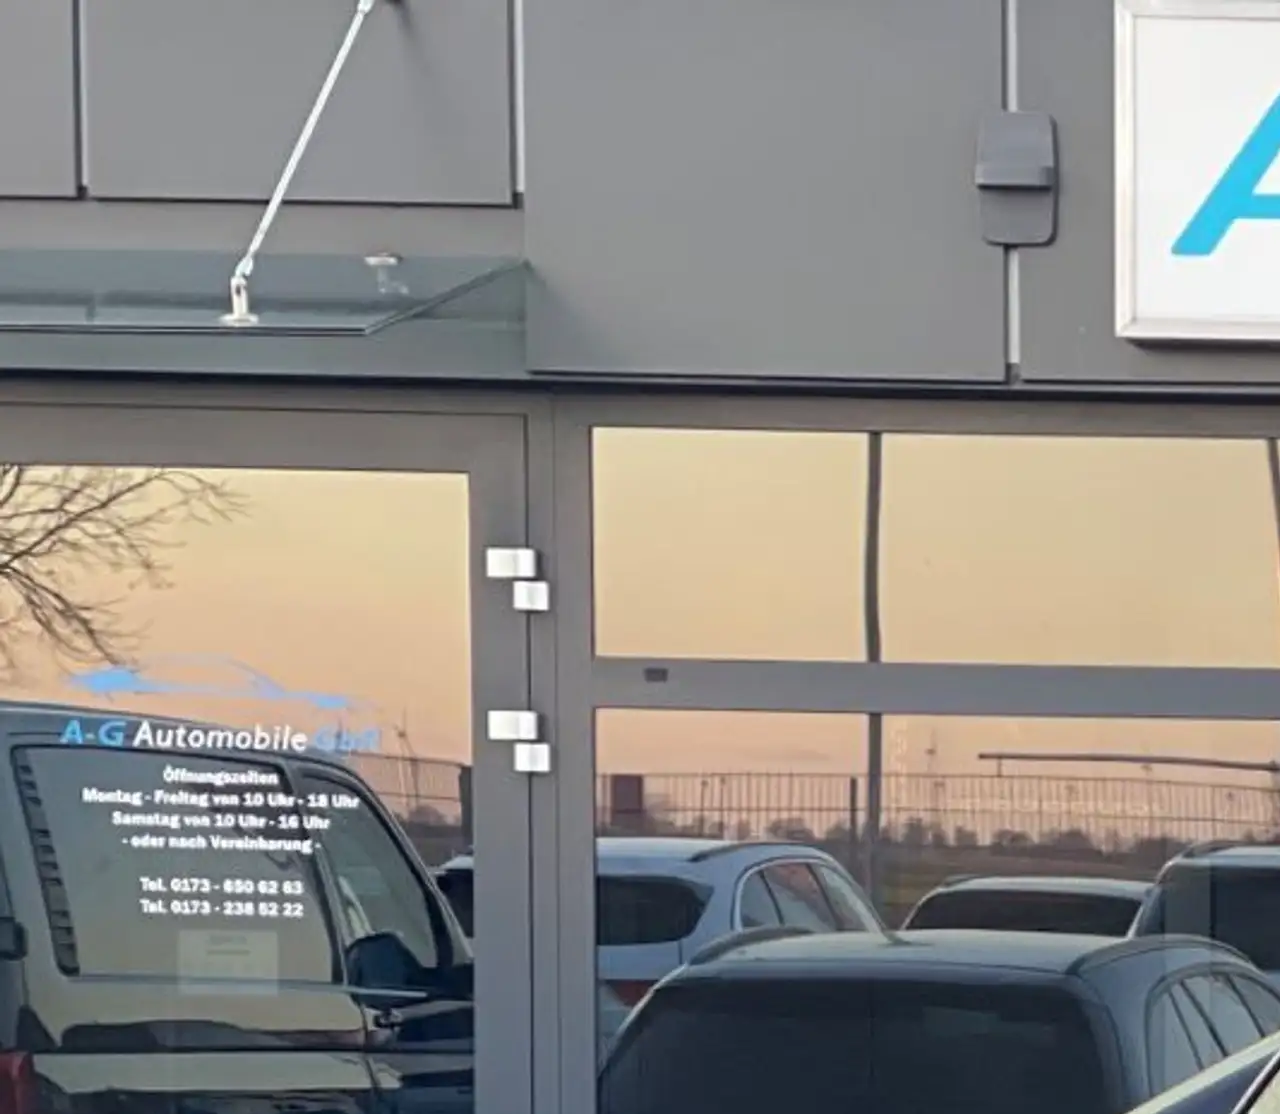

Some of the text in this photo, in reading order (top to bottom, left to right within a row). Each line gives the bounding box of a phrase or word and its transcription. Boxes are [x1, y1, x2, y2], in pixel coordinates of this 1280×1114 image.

[59, 719, 379, 751] A-G Automobile GbR
[163, 765, 279, 786] Öffnungszeiten
[82, 788, 143, 806] Montag
[154, 790, 208, 808] Freitag
[212, 794, 239, 806] von
[243, 793, 264, 807] 10
[267, 793, 295, 807] Uhr
[307, 794, 328, 808] 18
[331, 794, 359, 808] Uhr
[112, 811, 180, 829] Samstag
[183, 816, 211, 828] von
[214, 814, 235, 827] 10
[238, 814, 266, 828] Uhr
[278, 815, 298, 829] 16
[302, 816, 330, 829] Uhr
[130, 835, 165, 848] oder
[168, 835, 207, 849] nach
[209, 835, 313, 854] Vereinbarung
[139, 877, 167, 892] Tel.
[170, 878, 211, 893] 0173
[139, 899, 167, 914] Tel.
[170, 900, 211, 914] 0173
[282, 902, 304, 917] 22
